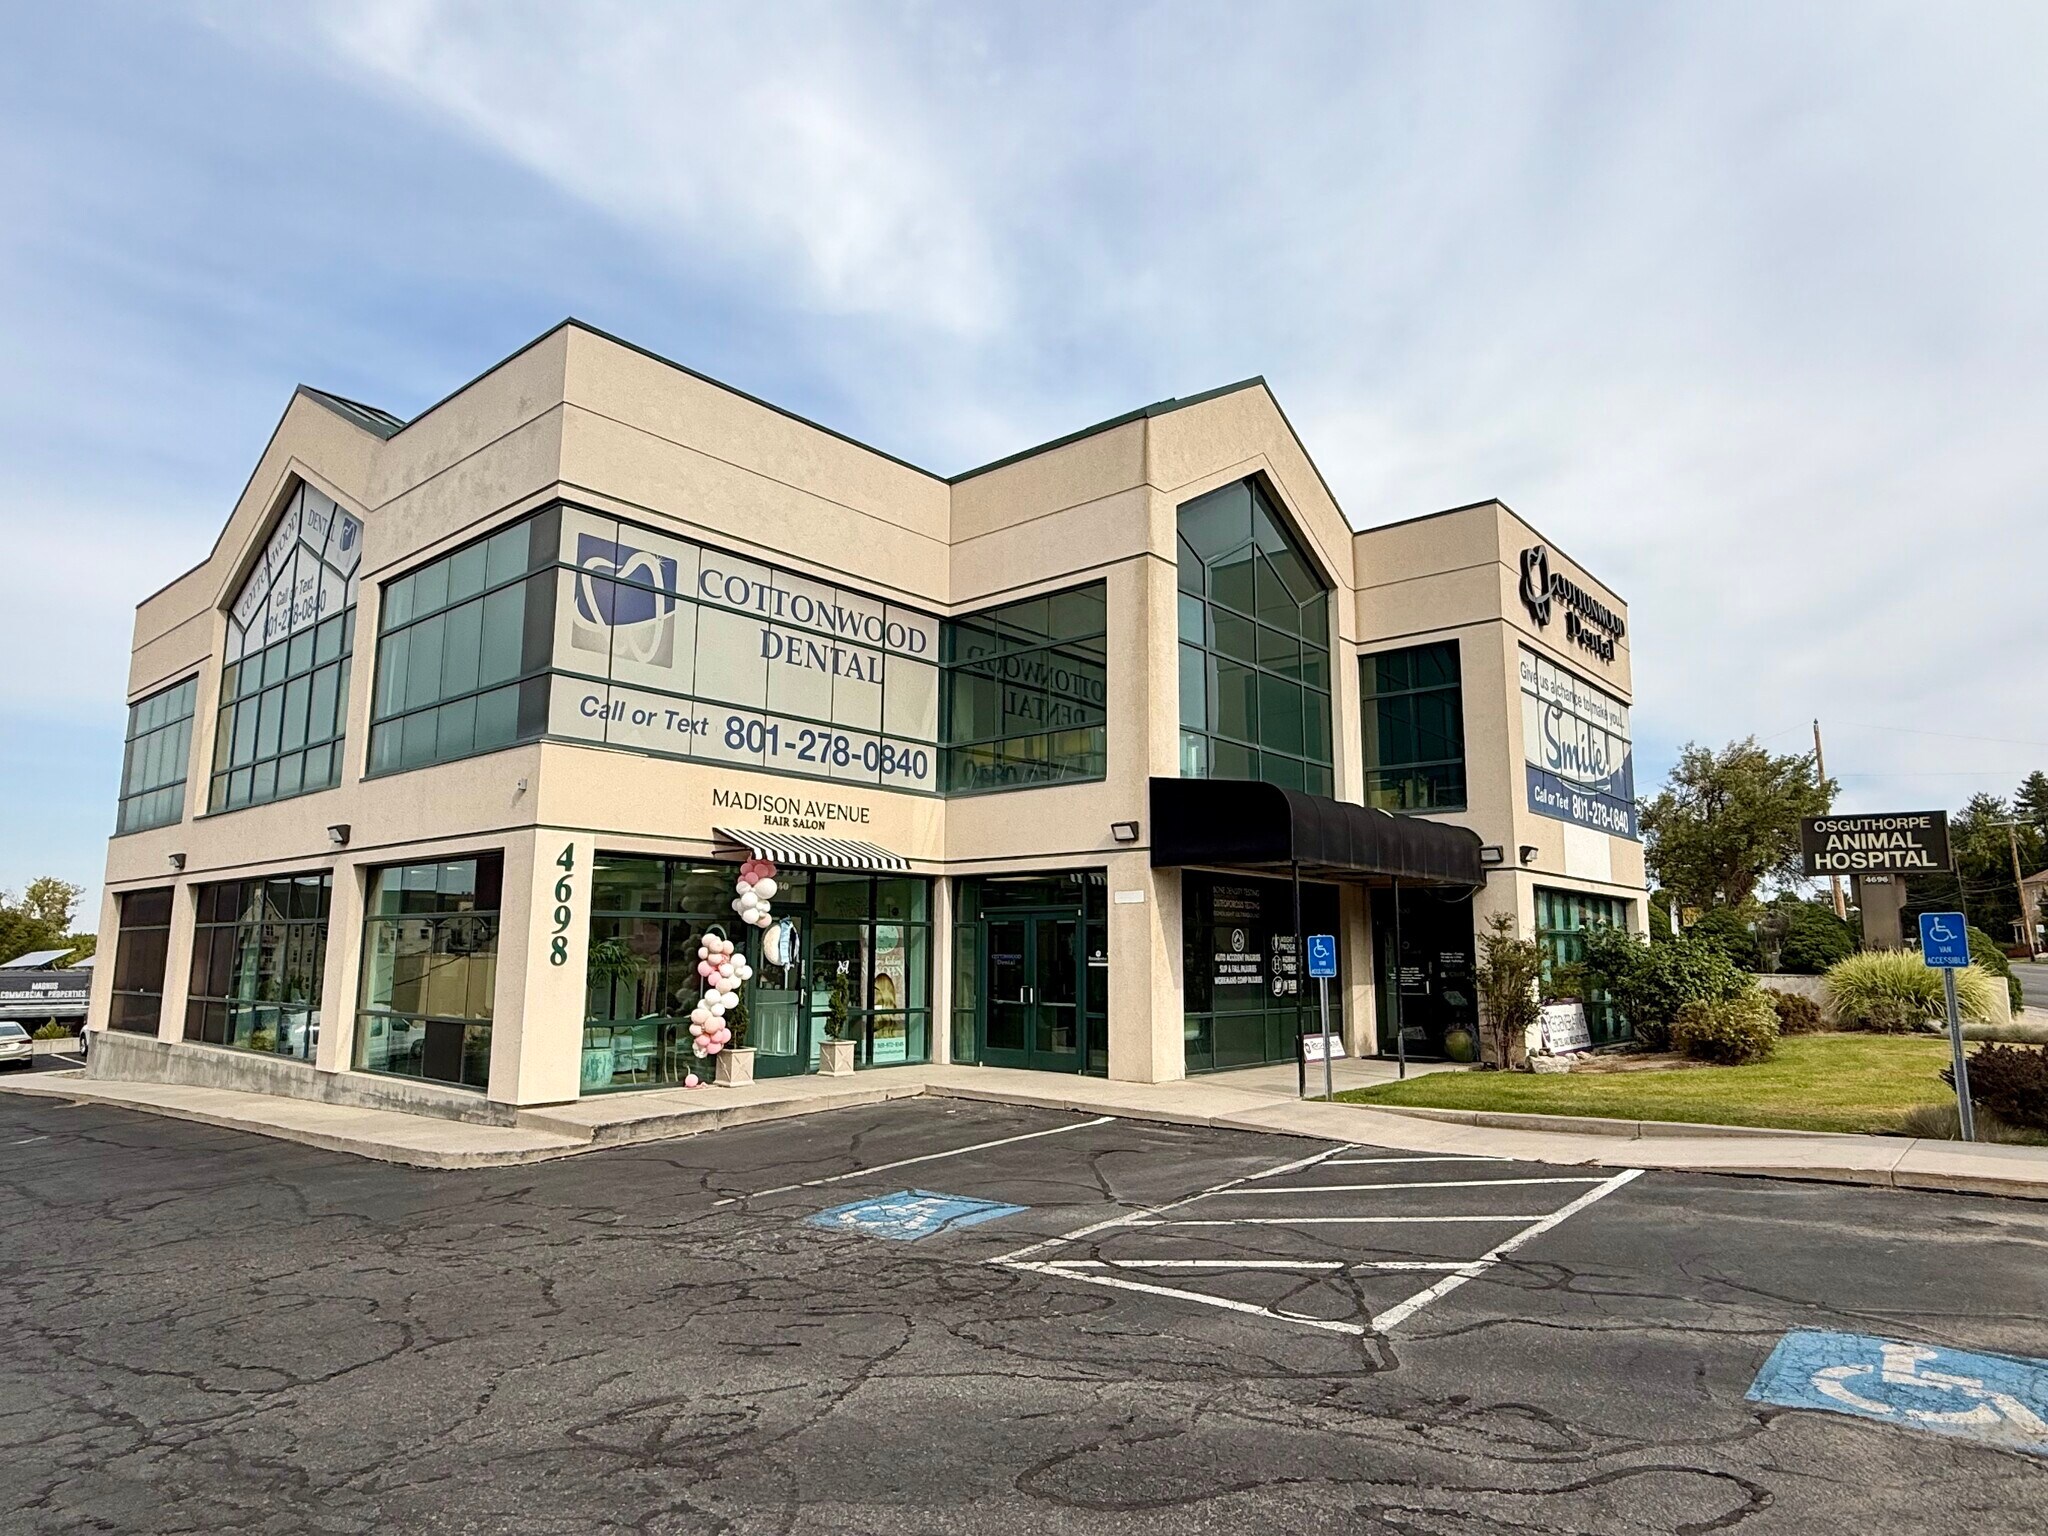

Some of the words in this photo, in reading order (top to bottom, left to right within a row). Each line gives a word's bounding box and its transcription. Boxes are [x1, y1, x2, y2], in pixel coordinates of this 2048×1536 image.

[307, 509, 336, 542] DENTL
[699, 568, 927, 654] COTTONWOOD
[760, 628, 884, 685] DENTAL
[1540, 674, 1549, 692] us
[579, 695, 626, 722] Call
[631, 707, 658, 727] or
[664, 710, 709, 736] Text
[724, 715, 928, 781] 801-278-0840
[712, 788, 801, 815] MADISON
[804, 801, 870, 824] AVENUE
[763, 815, 790, 827] HAIR
[793, 818, 826, 831] SALON
[1814, 816, 1931, 833] OSGUTHORPE
[1826, 831, 1923, 851] ANIMAL
[1814, 850, 1938, 870] HOSPITAL
[1864, 875, 1889, 884] 4696
[550, 842, 575, 966] 4698
[1927, 956, 1967, 965] ACCESSIBLE
[0, 990, 45, 999] COMMERCIAL
[48, 990, 87, 998] PROPERTIES
